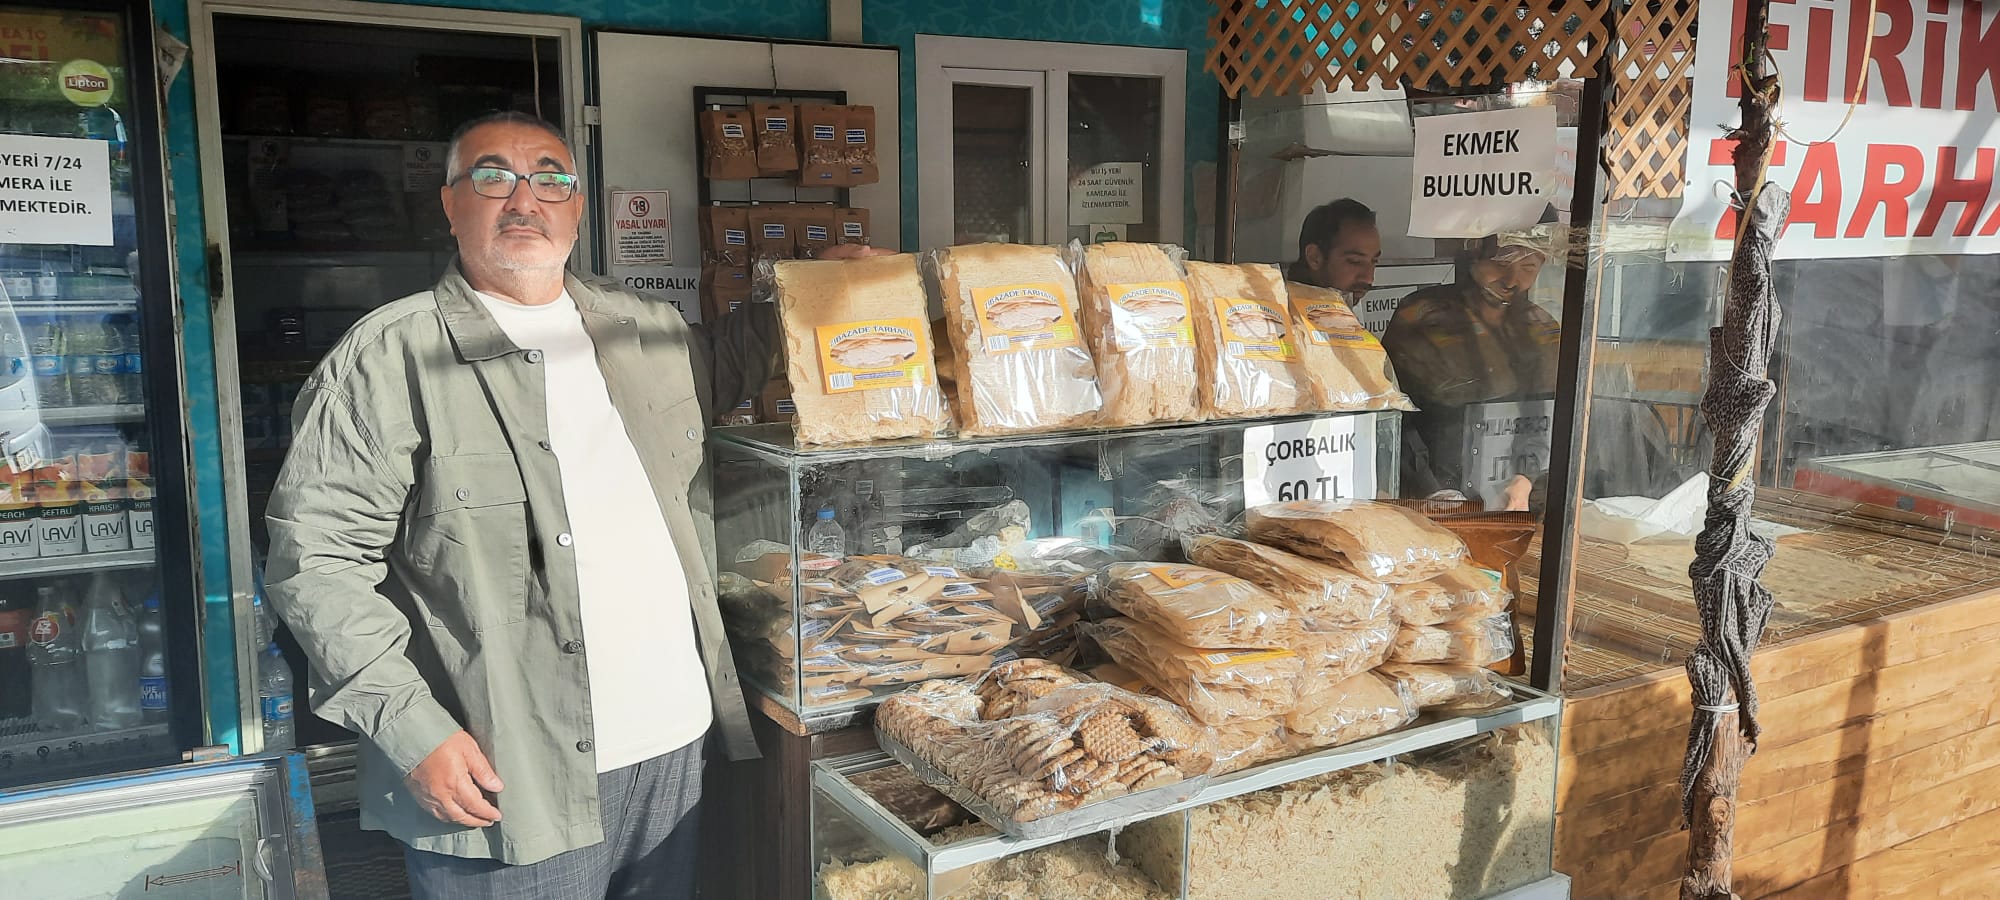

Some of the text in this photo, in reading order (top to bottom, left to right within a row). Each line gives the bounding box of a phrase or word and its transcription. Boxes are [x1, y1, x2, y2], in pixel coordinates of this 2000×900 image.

[69, 77, 105, 90] Lipton
[1443, 128, 1520, 156] EKMEK
[0, 152, 82, 171] YERİ 7/24
[49, 175, 73, 192] İLE
[1423, 171, 1540, 198] BULUNUR.
[0, 199, 92, 215] MEKTEDİR.
[616, 218, 667, 230] YASAL UYARI
[1265, 432, 1356, 467] ÇORBALIK
[1278, 475, 1345, 503] 60 TL
